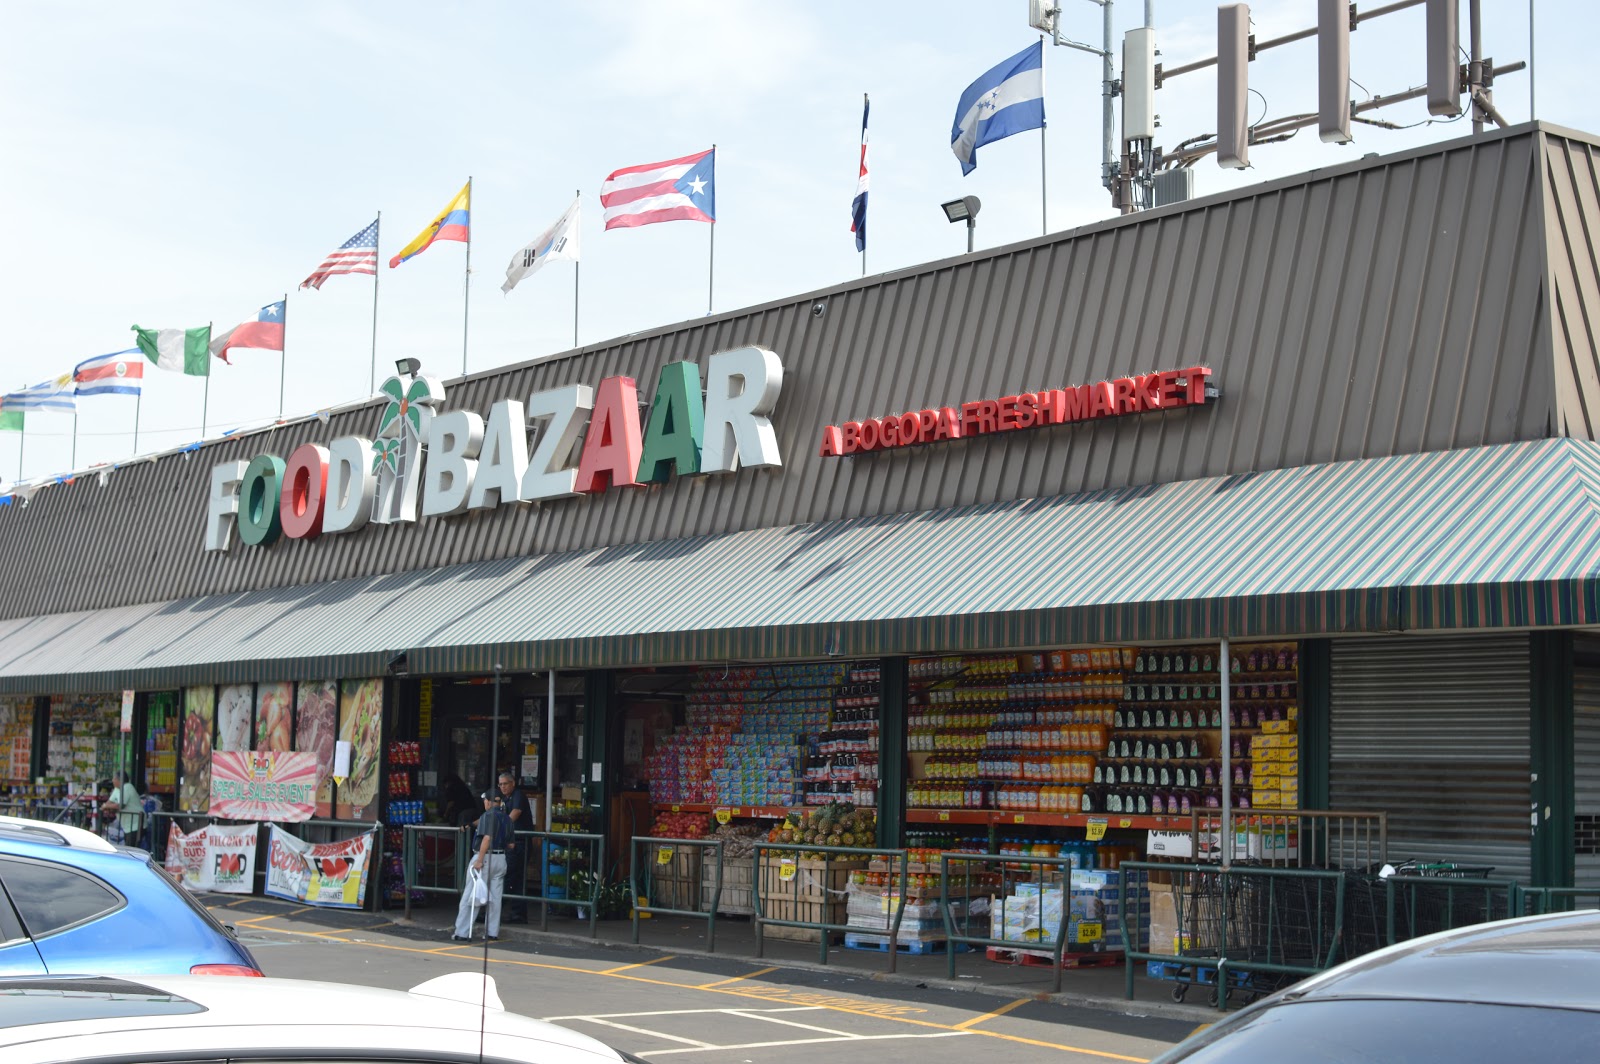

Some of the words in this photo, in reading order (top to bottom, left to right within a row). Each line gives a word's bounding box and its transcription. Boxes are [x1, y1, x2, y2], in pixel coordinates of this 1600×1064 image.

[818, 425, 842, 457] A
[842, 407, 962, 449] BOGOPA
[960, 389, 1066, 436] FRESH
[1063, 366, 1212, 422] MARKET
[205, 436, 374, 551] FOOD
[422, 346, 784, 516] BAZAAR
[212, 780, 247, 801] SPECIAL
[247, 782, 277, 802] SALES
[278, 783, 312, 804] EVENT
[246, 835, 256, 847] TO
[183, 848, 206, 858] BUDS
[1083, 929, 1097, 937] $2.99
